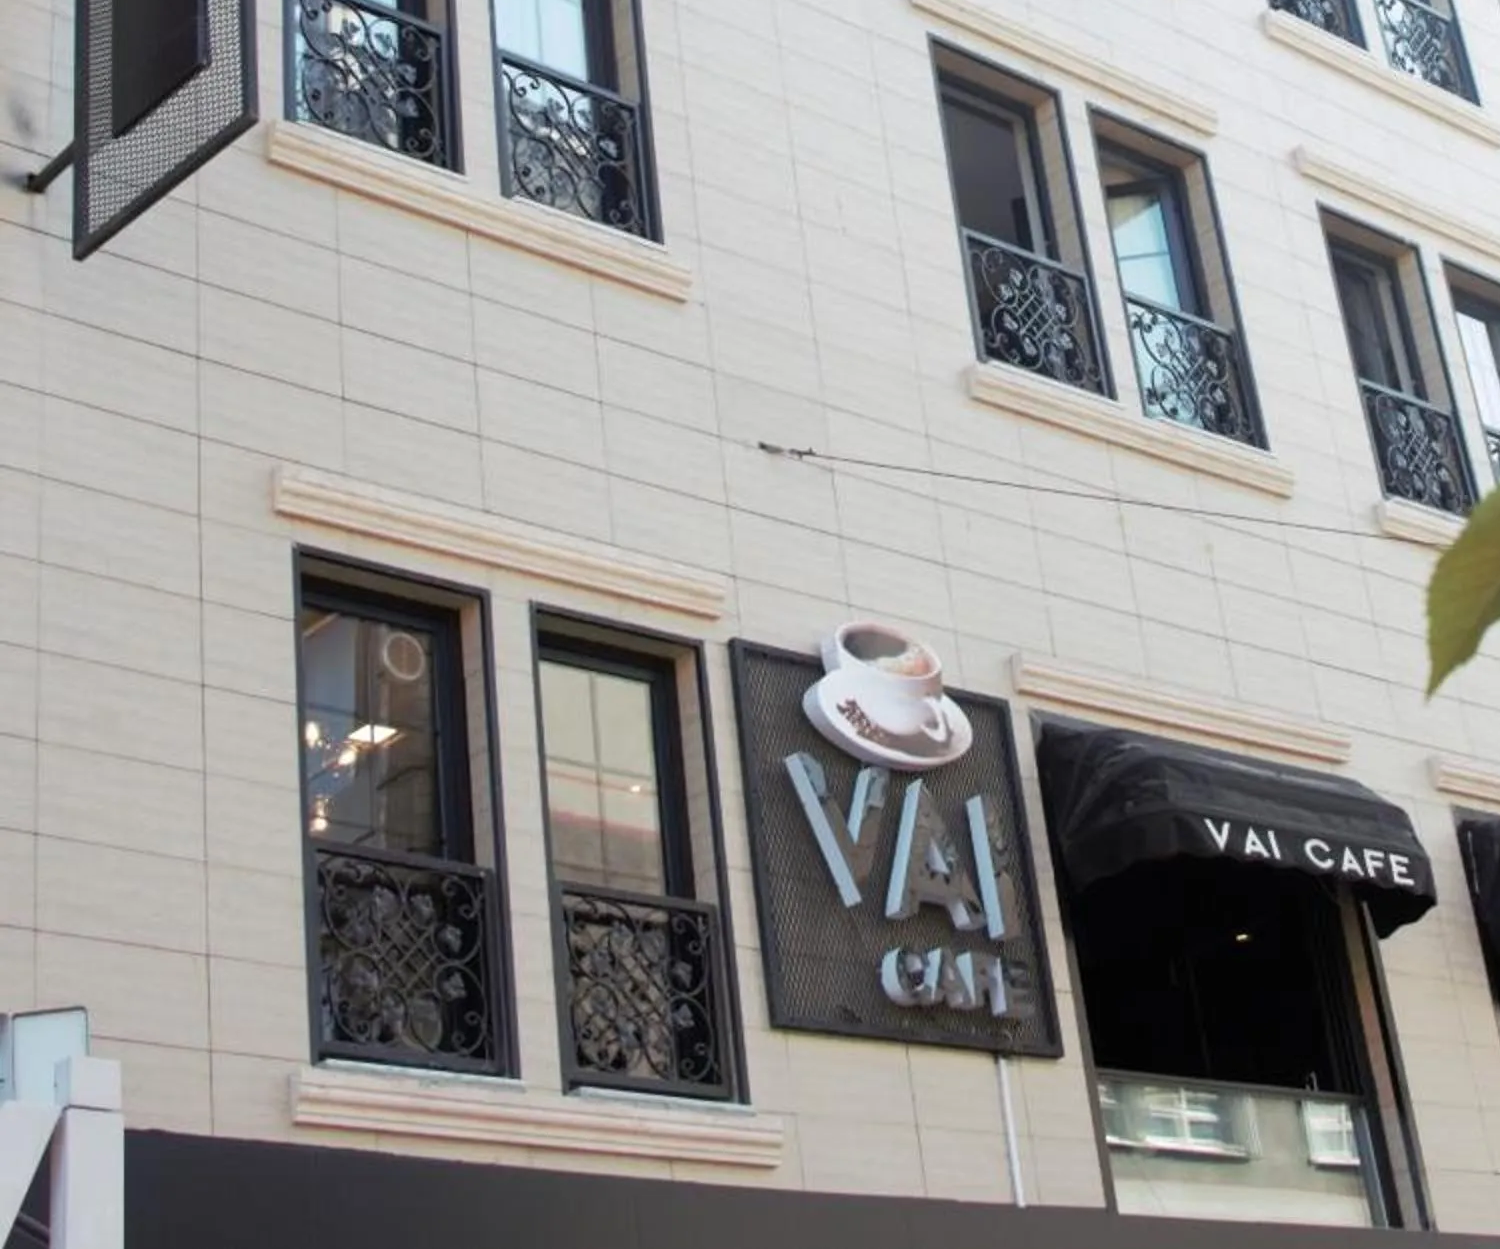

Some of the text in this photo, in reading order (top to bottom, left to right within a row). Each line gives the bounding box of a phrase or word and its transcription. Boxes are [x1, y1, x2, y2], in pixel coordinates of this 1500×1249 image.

[784, 752, 1020, 941] VAI
[1203, 817, 1415, 886] VAI CAFE
